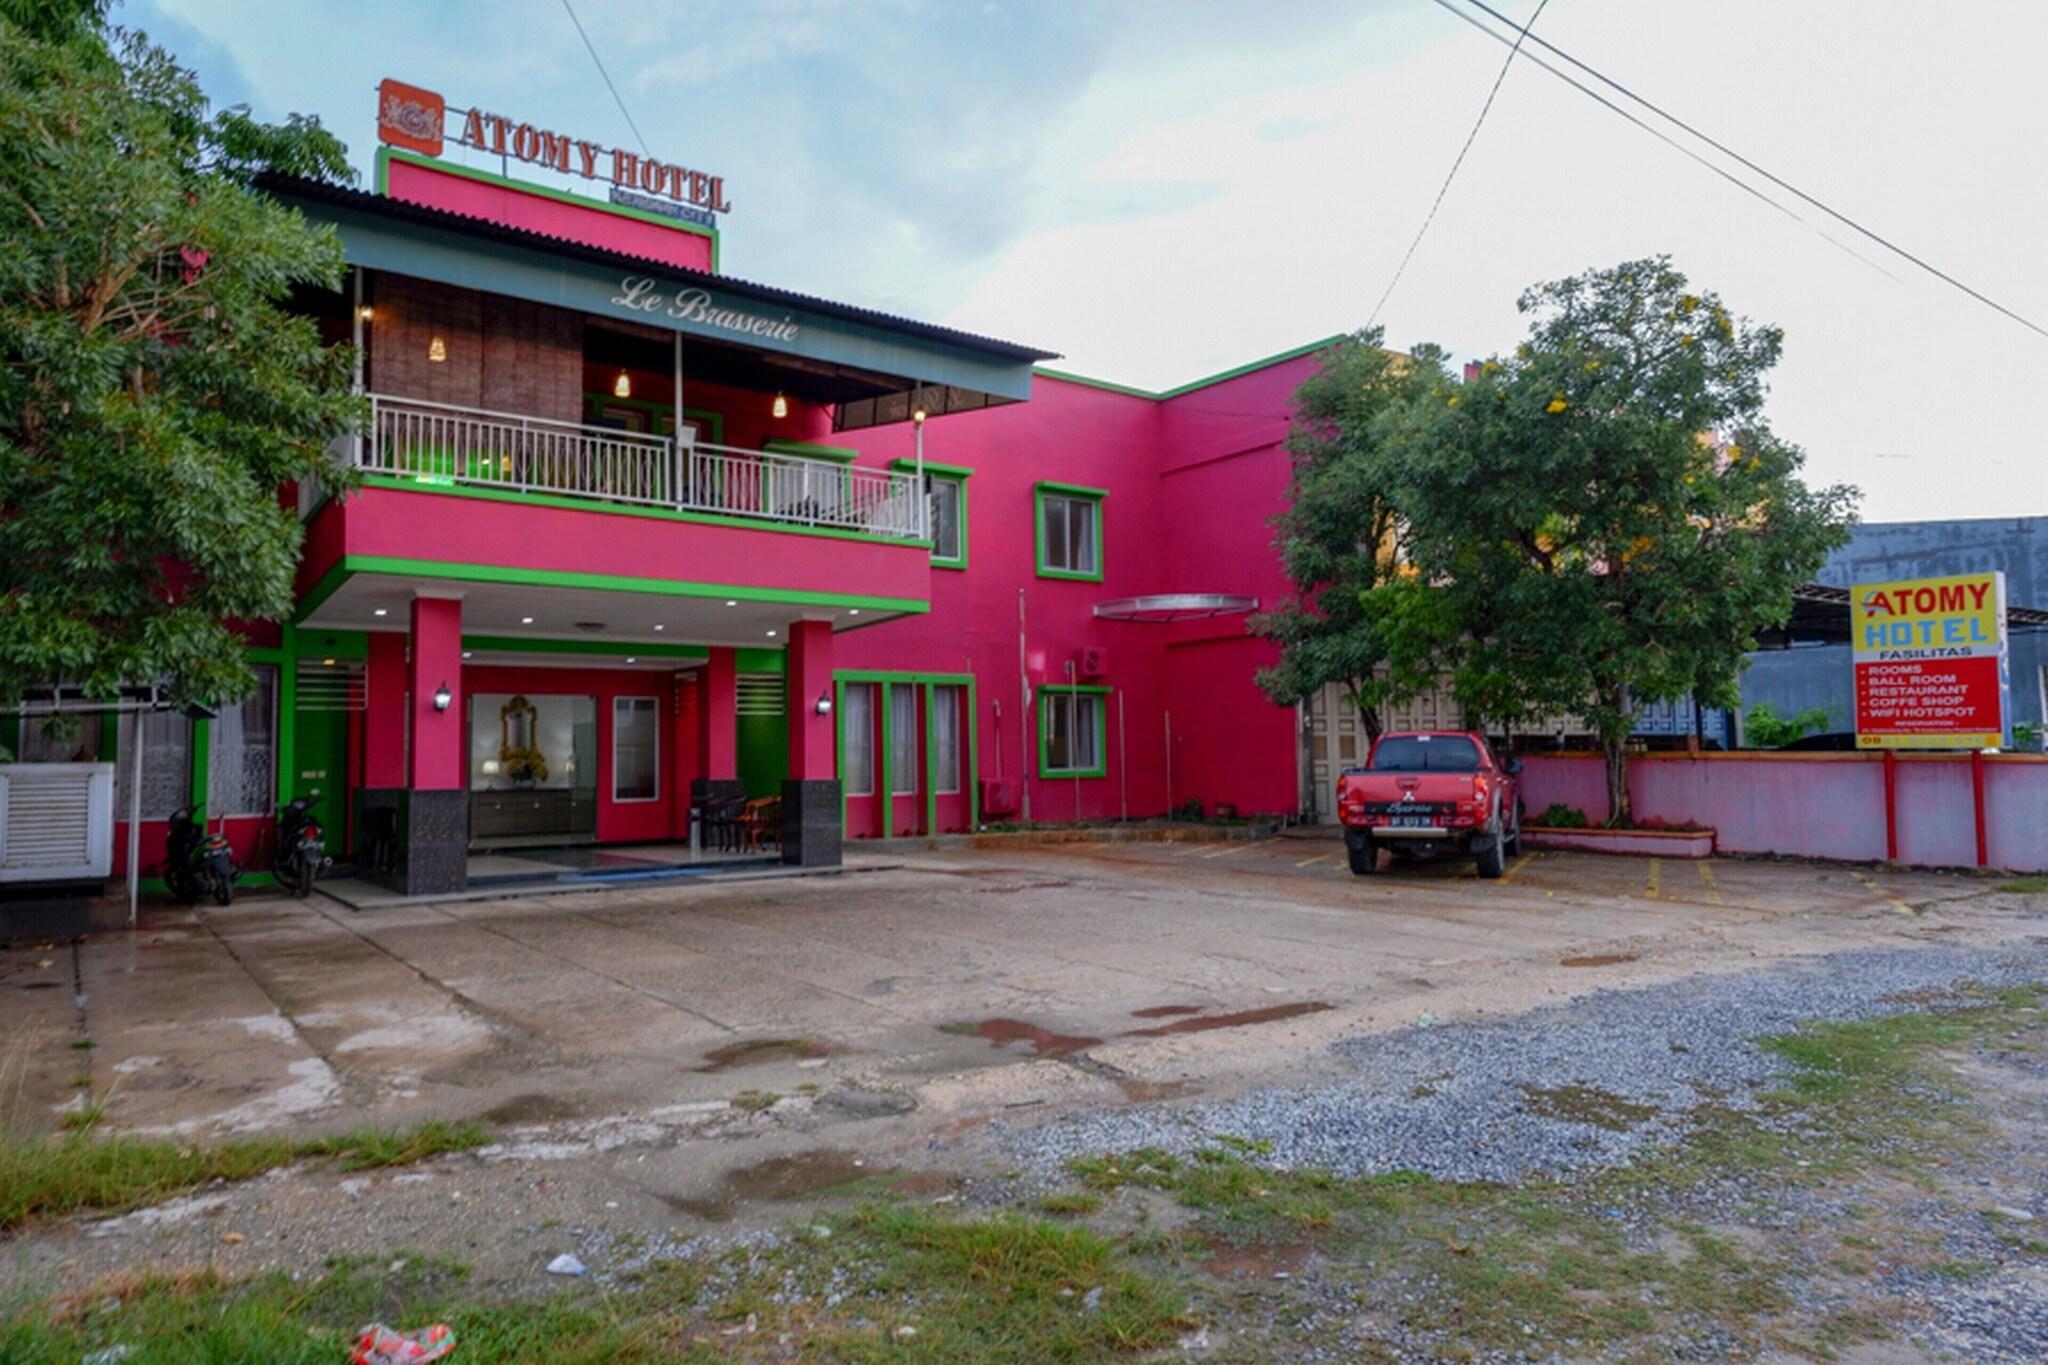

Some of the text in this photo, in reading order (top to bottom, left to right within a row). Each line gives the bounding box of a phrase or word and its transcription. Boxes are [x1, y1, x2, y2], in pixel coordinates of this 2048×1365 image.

[460, 107, 731, 214] ATOMY HOTEL
[611, 276, 799, 341] Le Brasserie
[1863, 582, 1990, 616] ATOMY
[1865, 617, 1988, 647] HOTEL
[1880, 647, 1972, 660] FASILITAS
[1868, 665, 1922, 675] ROOMS
[1868, 674, 1956, 685] BALL ROOM
[1869, 684, 1968, 696] RESTAURANT
[1869, 696, 1964, 707] COFFE SHOP
[1869, 706, 1975, 717] WIFI HOTSPOT
